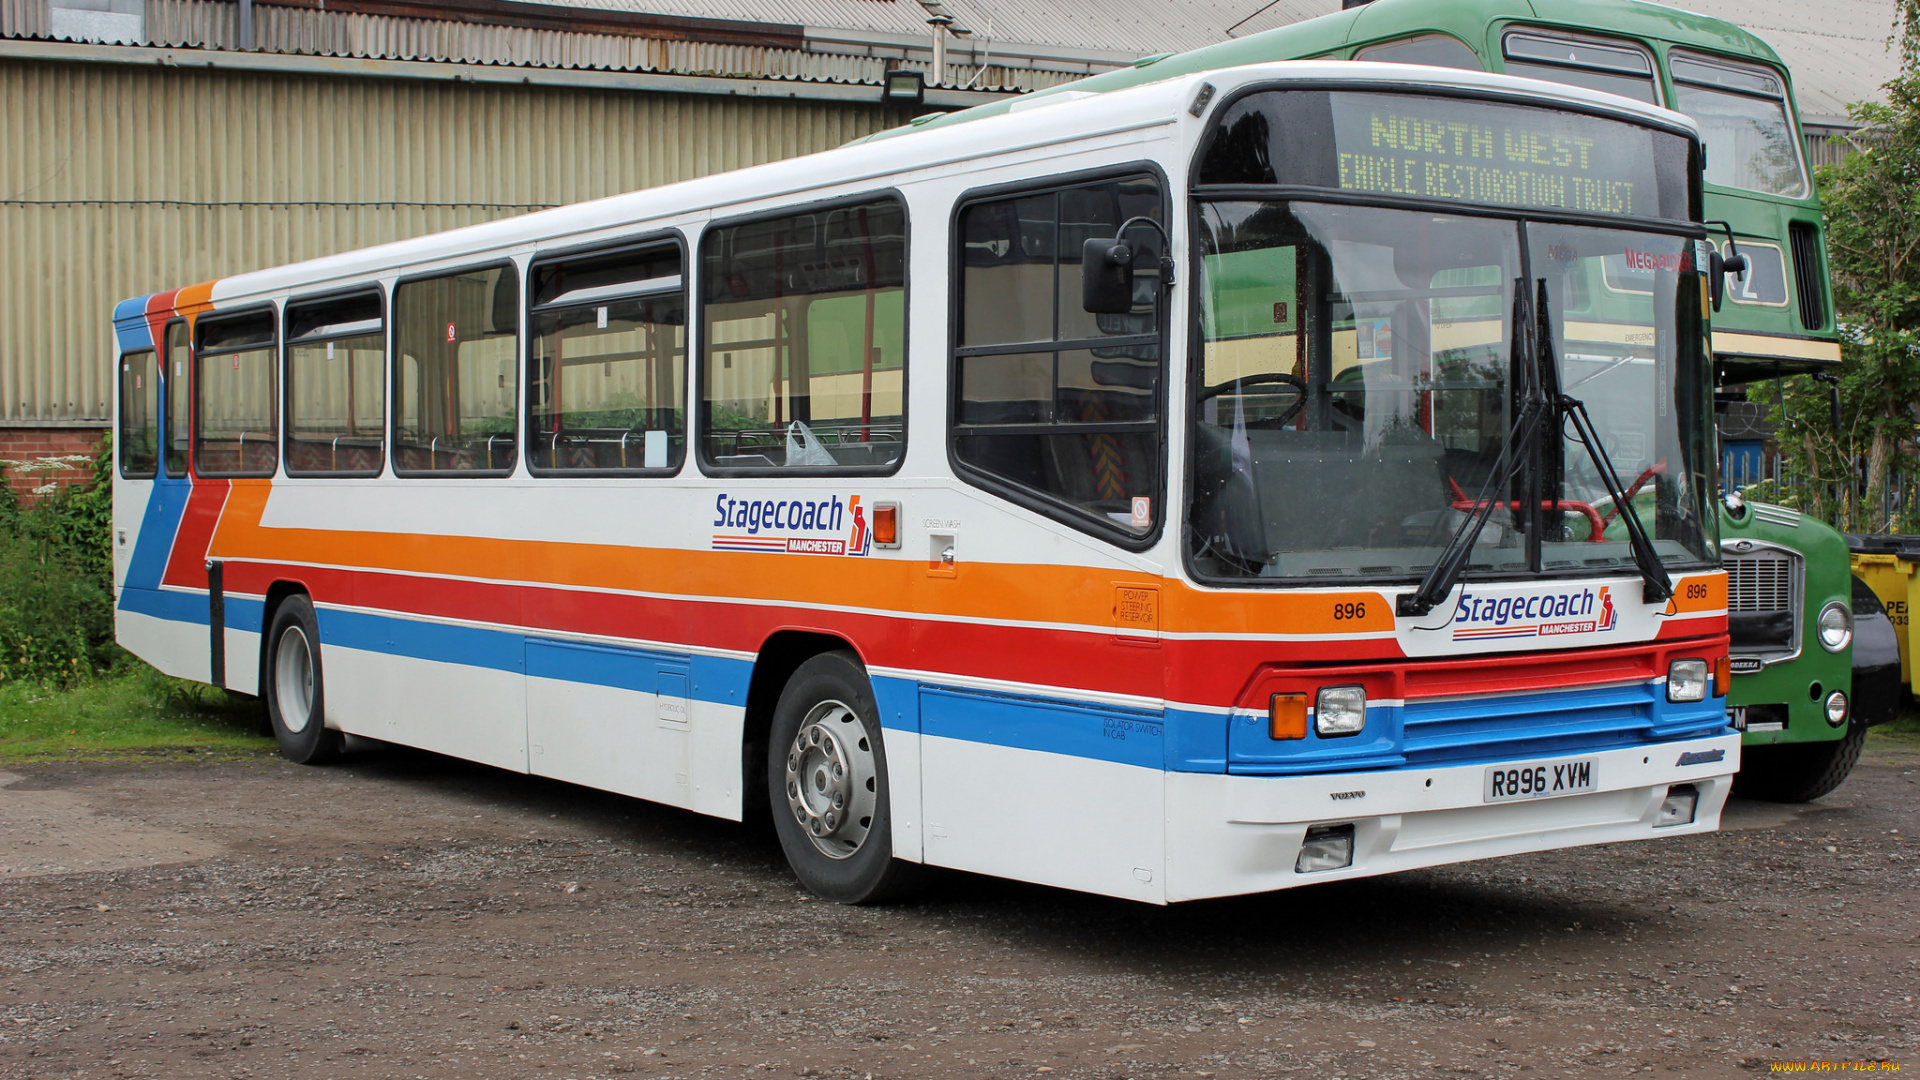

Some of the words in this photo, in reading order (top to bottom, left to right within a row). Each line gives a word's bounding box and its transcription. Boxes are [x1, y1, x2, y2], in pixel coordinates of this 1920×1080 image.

[1371, 112, 1493, 159] NORTH
[1504, 127, 1594, 169] WEST
[1425, 161, 1565, 208] RESTORATION
[1572, 177, 1634, 214] TRUST
[1625, 247, 1692, 272] MEGARIDER
[713, 493, 843, 534] Stagecoach
[922, 518, 944, 528] SCREEN
[944, 519, 962, 529] WASH
[789, 539, 843, 554] MANCHESTER
[1123, 590, 1149, 601] POWER
[1687, 584, 1707, 599] 896
[1121, 601, 1152, 613] STEERING
[1333, 602, 1366, 620] 896
[1455, 588, 1594, 626] Stagecoach
[1541, 622, 1594, 635] MANCHESTER
[1111, 729, 1126, 741] CAB
[1135, 723, 1163, 736] SWITCH
[1492, 766, 1547, 797] R896
[1552, 761, 1591, 791] XVM
[1330, 790, 1366, 801] VOLVO
